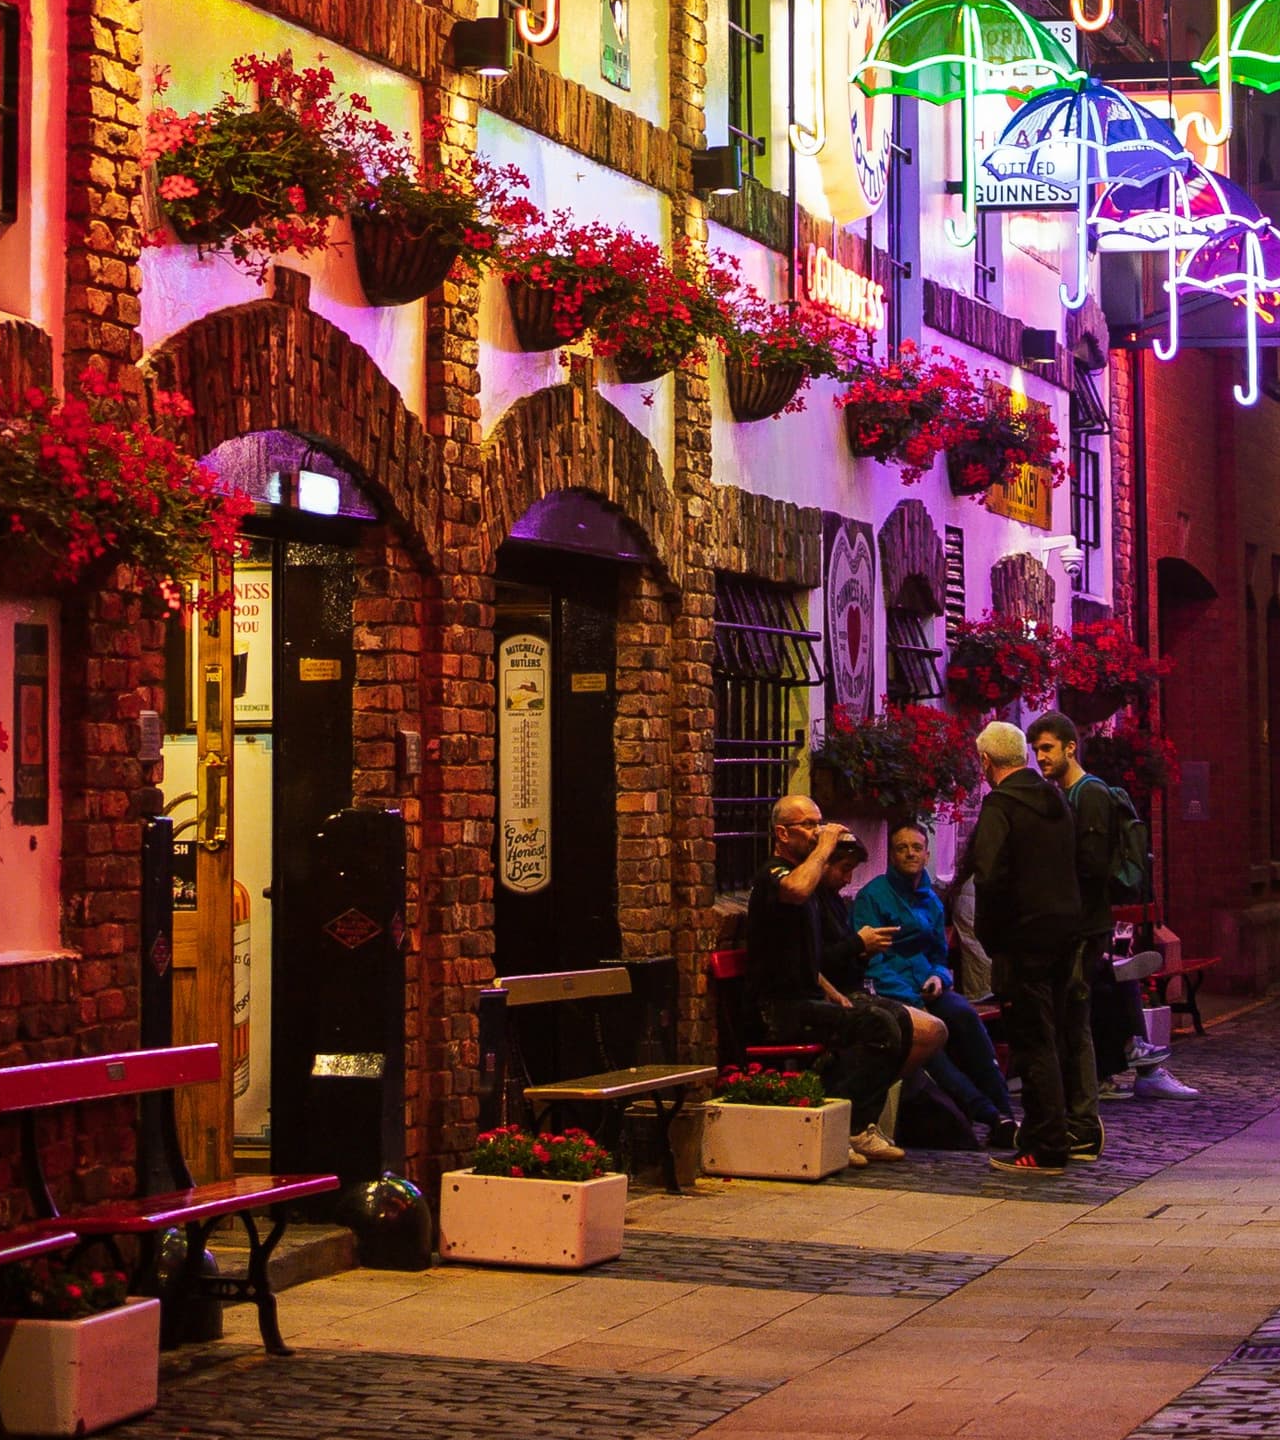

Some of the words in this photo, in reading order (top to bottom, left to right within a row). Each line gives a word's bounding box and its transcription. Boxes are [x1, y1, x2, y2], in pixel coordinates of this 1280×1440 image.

[975, 184, 1074, 203] GUINNESS
[505, 643, 545, 657] MITCHELLS
[510, 658, 541, 668] BUTLERS
[506, 844, 546, 863] Honest
